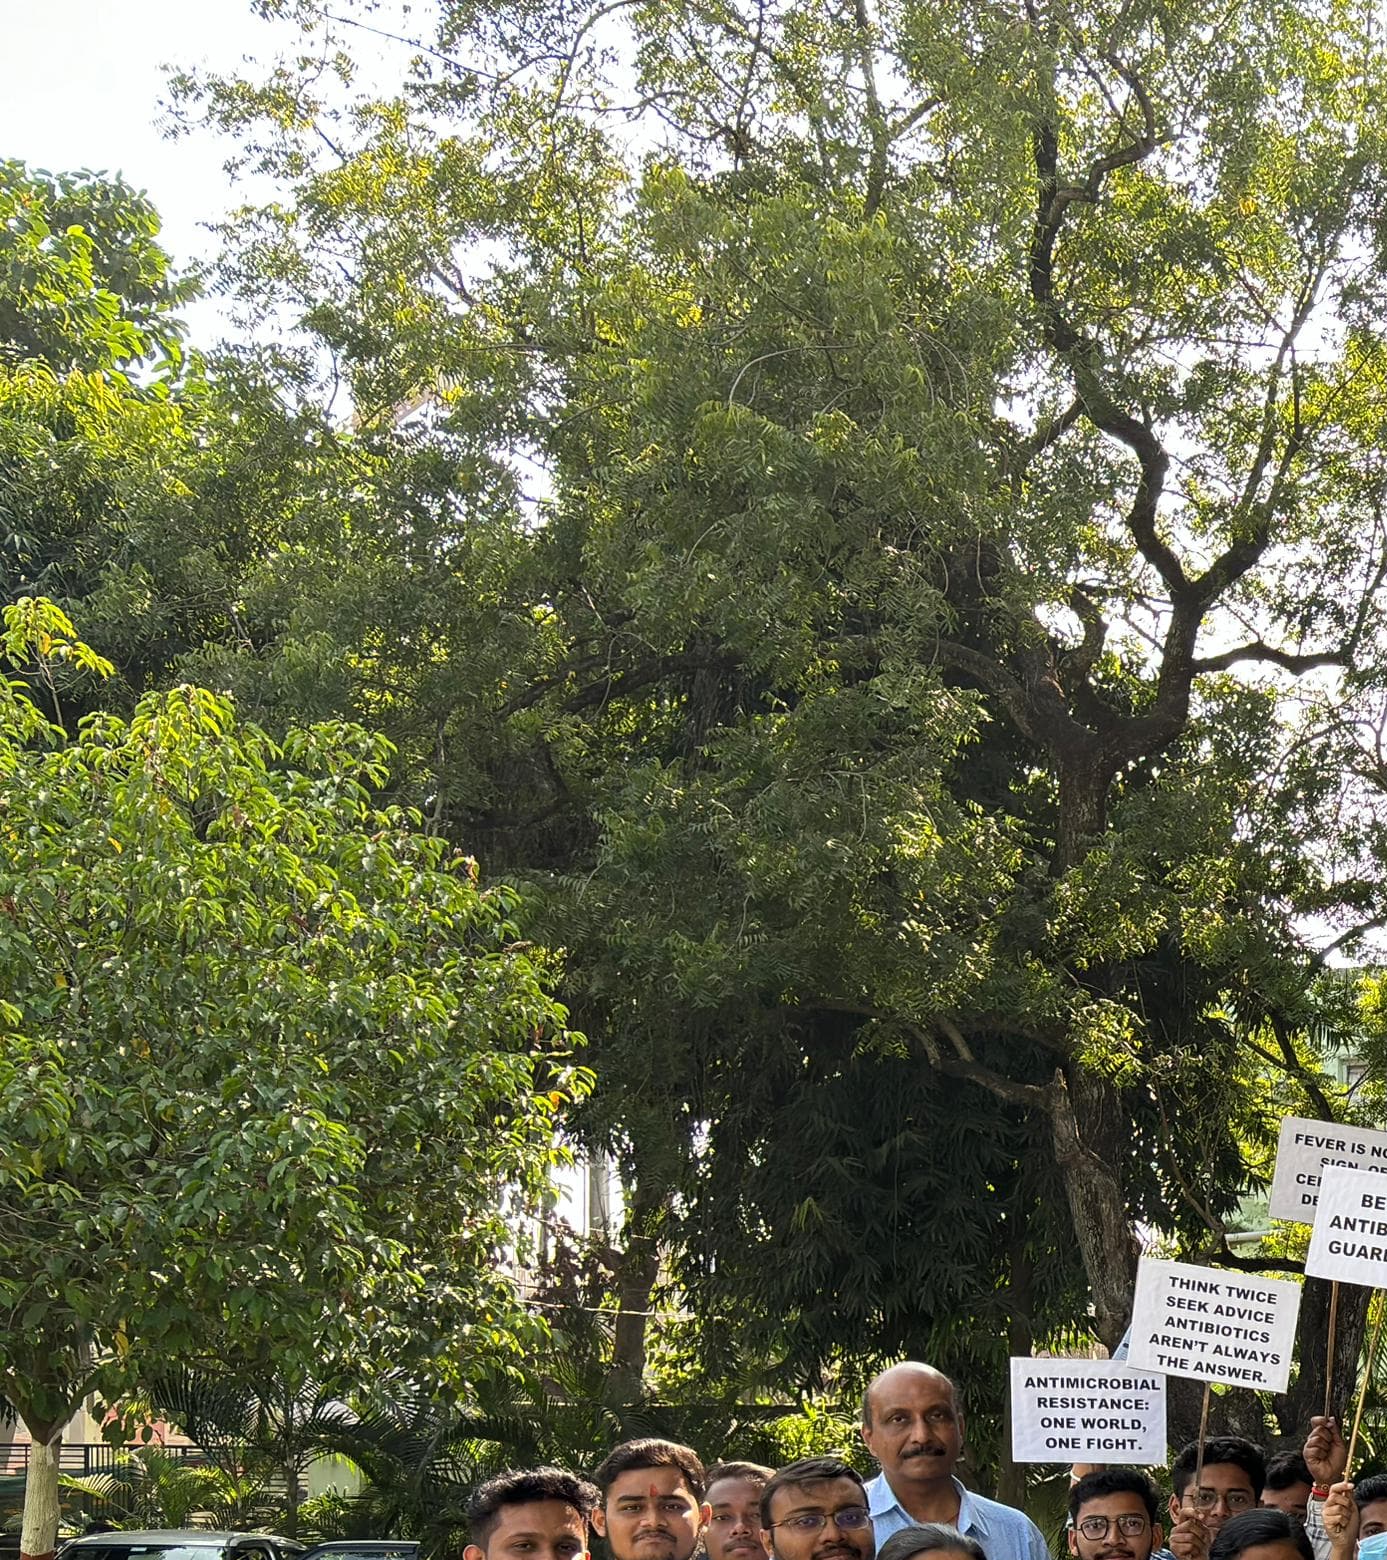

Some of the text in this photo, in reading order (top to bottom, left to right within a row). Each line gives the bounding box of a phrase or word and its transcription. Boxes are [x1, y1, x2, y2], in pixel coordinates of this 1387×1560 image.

[1295, 1134, 1345, 1151] FEVER
[1351, 1143, 1365, 1154] IS
[1361, 1194, 1386, 1210] BE
[1169, 1276, 1277, 1304] THINK TWICE
[1166, 1296, 1274, 1324] SEEK ADVICE
[1165, 1316, 1270, 1344] ANTIBIOTICS
[1213, 1345, 1280, 1364] ALWAYS
[1157, 1355, 1267, 1383] THE ANSWER.
[1025, 1377, 1160, 1390] ANTIMICROBIAL
[1038, 1397, 1149, 1410] RESISTANCE:
[1041, 1417, 1146, 1432] ONE WORLD,
[1046, 1438, 1142, 1450] ONE FIGHT.
